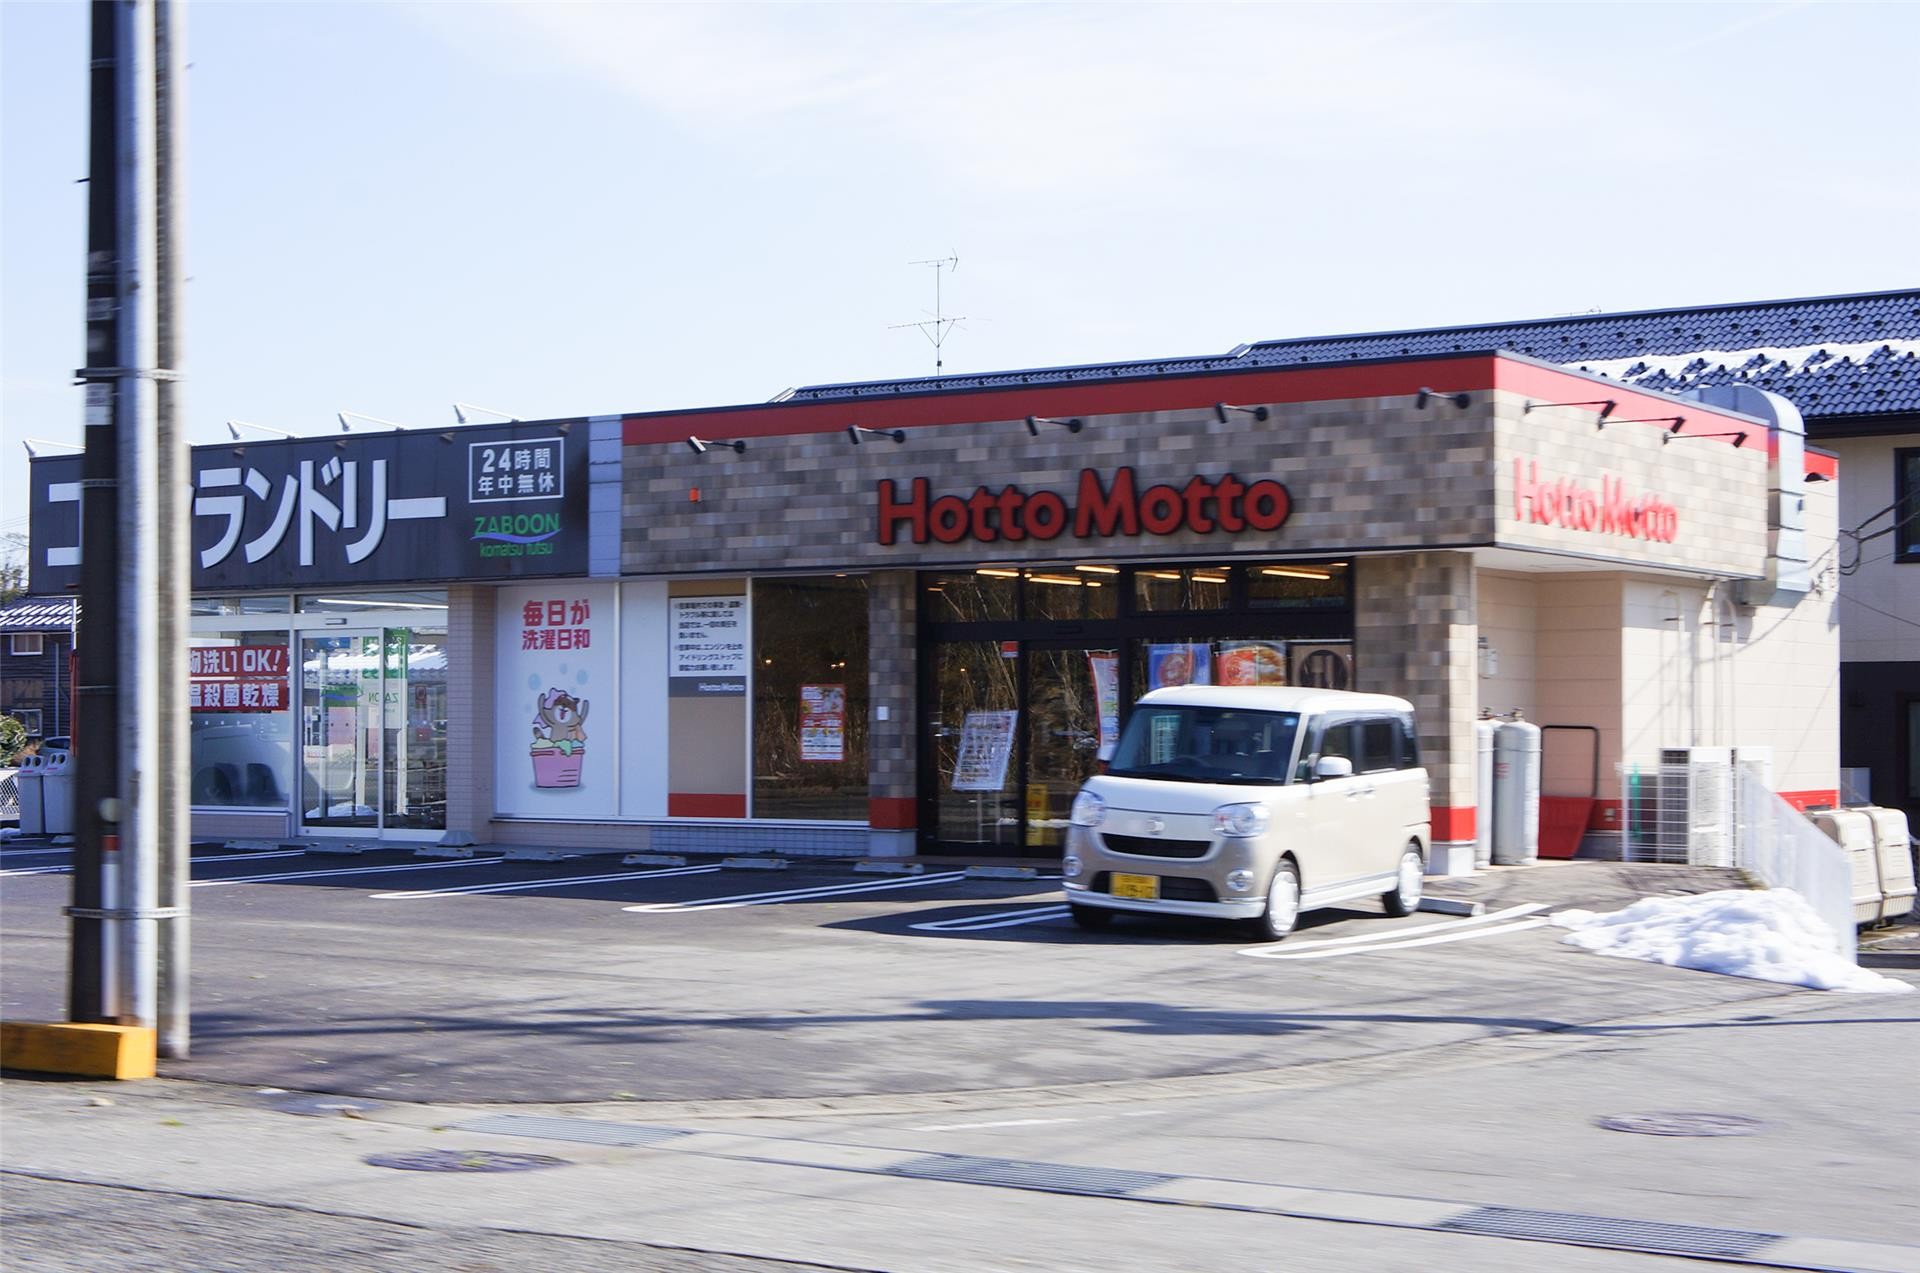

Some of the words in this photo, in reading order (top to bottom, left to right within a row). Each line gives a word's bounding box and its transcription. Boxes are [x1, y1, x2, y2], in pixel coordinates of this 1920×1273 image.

[482, 448, 551, 473] 24時間
[478, 472, 554, 495] 年中無休
[47, 456, 446, 569] コランドリー
[877, 476, 1067, 545] Hotto
[1073, 465, 1291, 537] Motto
[474, 512, 560, 537] ZABOON
[523, 599, 590, 627] 毎日が
[522, 629, 590, 650] 洗濯日和
